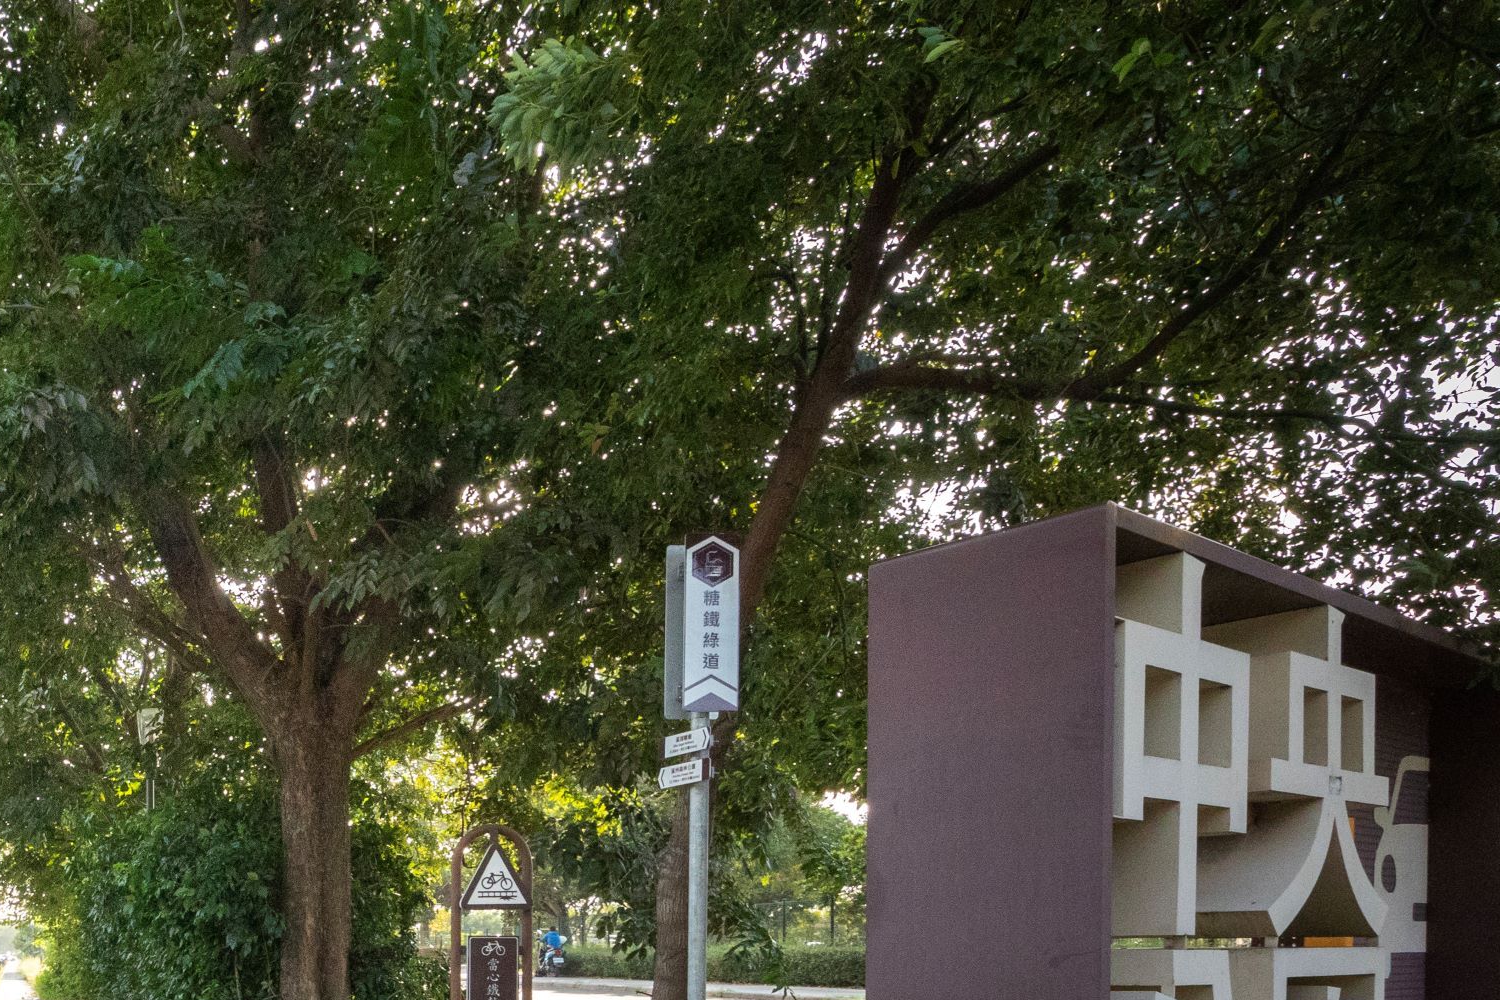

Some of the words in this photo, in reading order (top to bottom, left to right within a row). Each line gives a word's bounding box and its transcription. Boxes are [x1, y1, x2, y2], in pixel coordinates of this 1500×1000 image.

[703, 590, 720, 670] 糖鐵綠道
[1117, 550, 1390, 937] 中央
